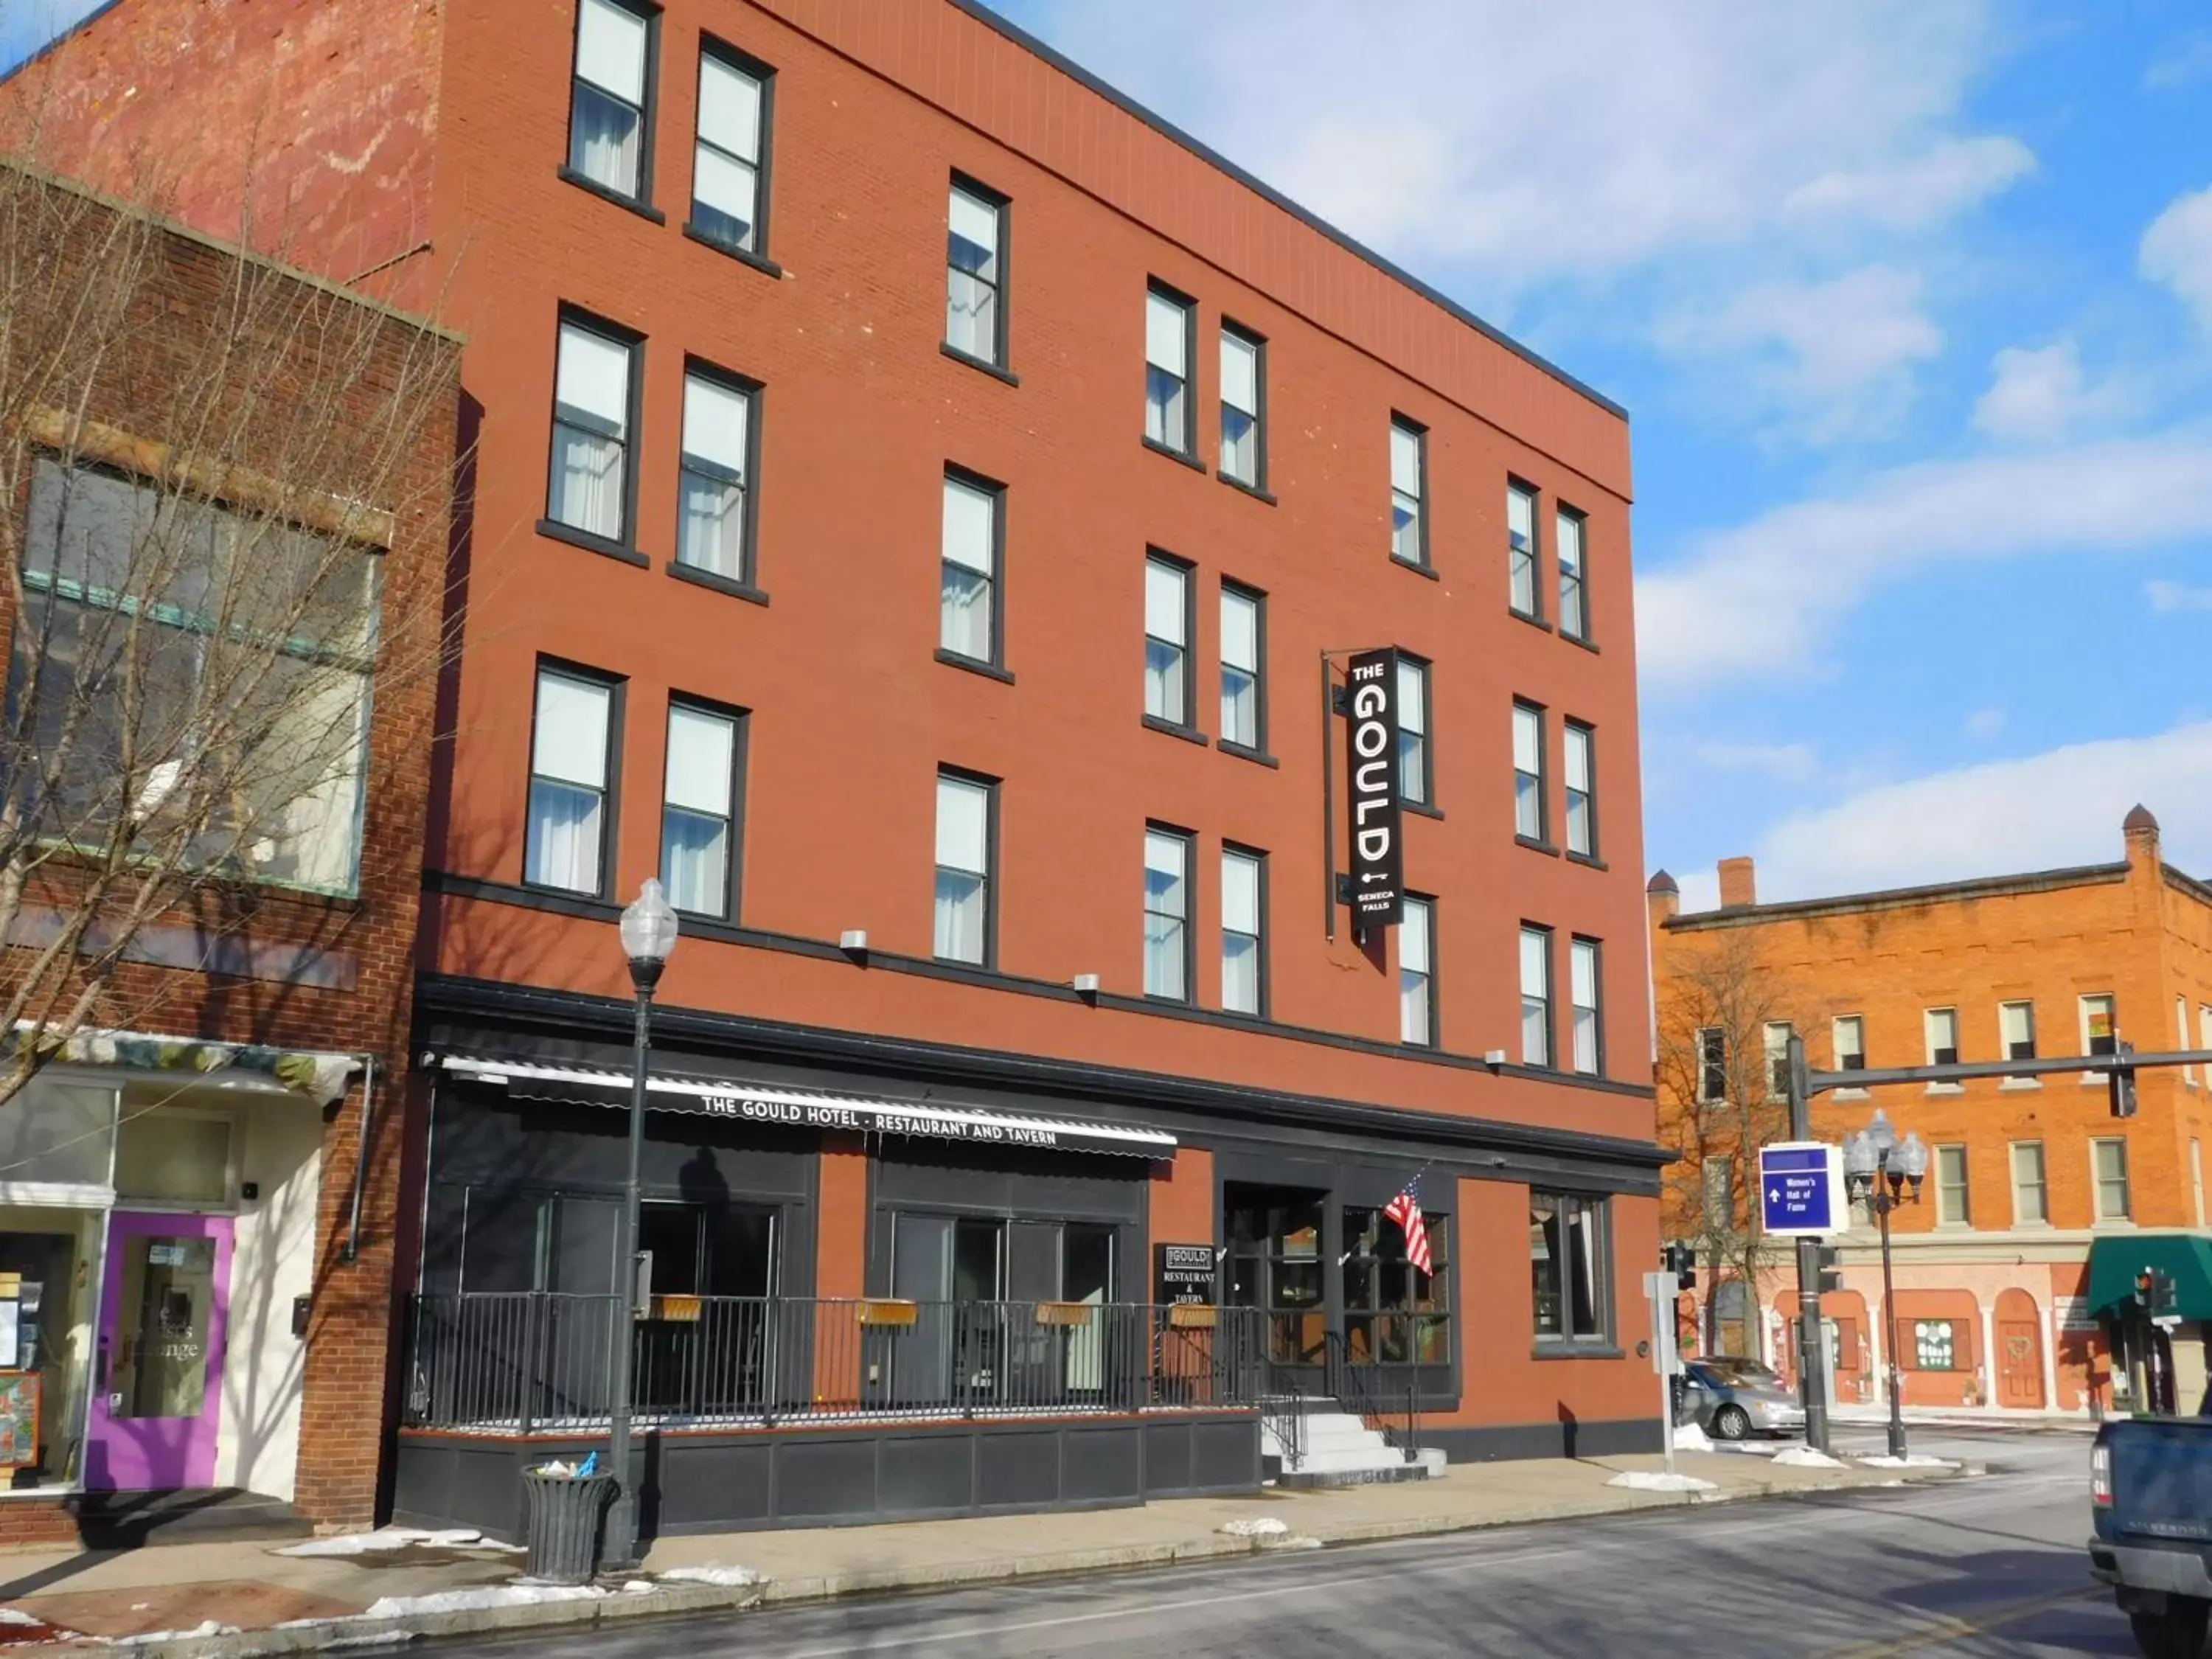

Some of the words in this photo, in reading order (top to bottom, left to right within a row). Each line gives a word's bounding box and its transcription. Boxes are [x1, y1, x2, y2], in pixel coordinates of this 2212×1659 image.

[1353, 663, 1384, 681] THE
[1354, 684, 1390, 861] GOULD
[1357, 891, 1394, 902] SENECA
[1362, 902, 1390, 912] FALLS
[702, 1096, 737, 1113] THE
[742, 1101, 801, 1121] GOULD
[807, 1107, 859, 1126] HOTEL
[875, 1114, 967, 1136] RESTAURANT
[973, 1124, 1002, 1140] AND
[1006, 1128, 1057, 1145] TAVERN
[1173, 1250, 1206, 1262] GOULD
[1164, 1272, 1215, 1283] RESTAURANT
